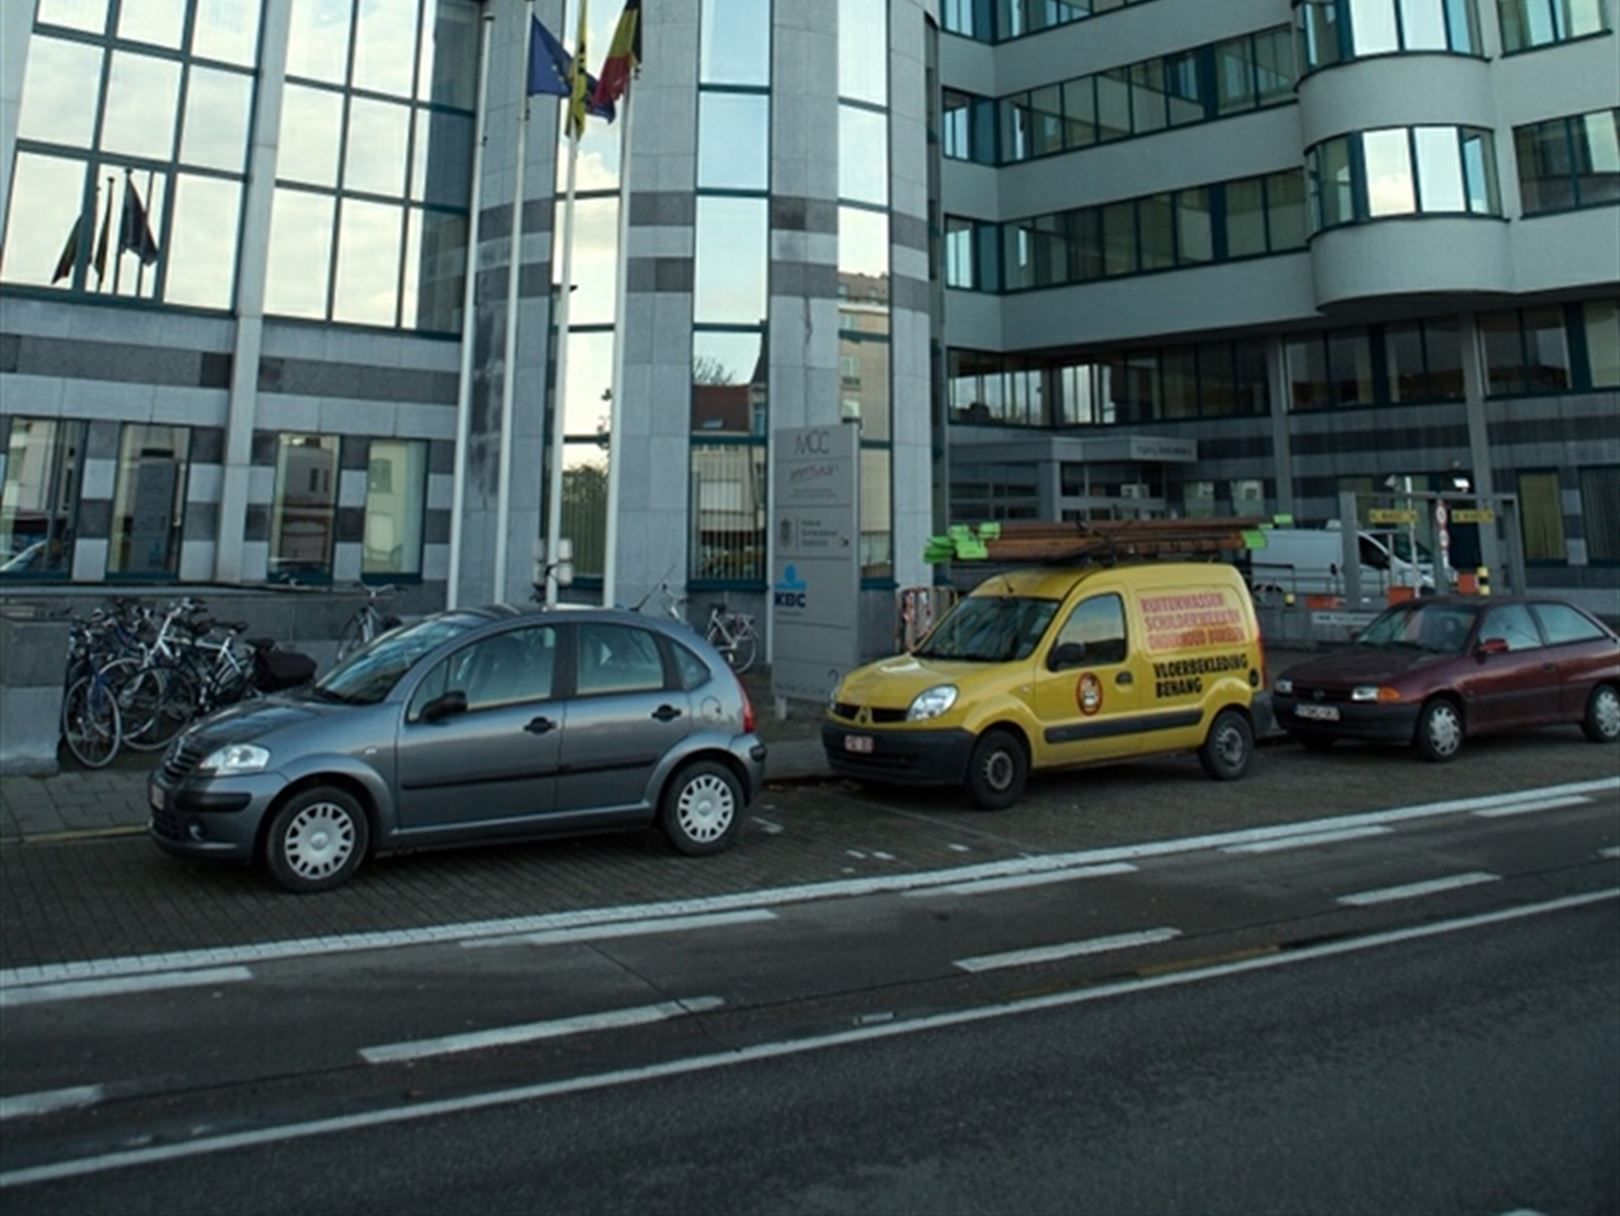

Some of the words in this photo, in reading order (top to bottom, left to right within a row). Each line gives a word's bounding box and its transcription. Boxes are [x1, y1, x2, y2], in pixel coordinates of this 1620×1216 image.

[774, 591, 807, 608] KBC
[1153, 653, 1248, 679] VLOERBEKLEDING
[1155, 677, 1202, 698] BEHANG
